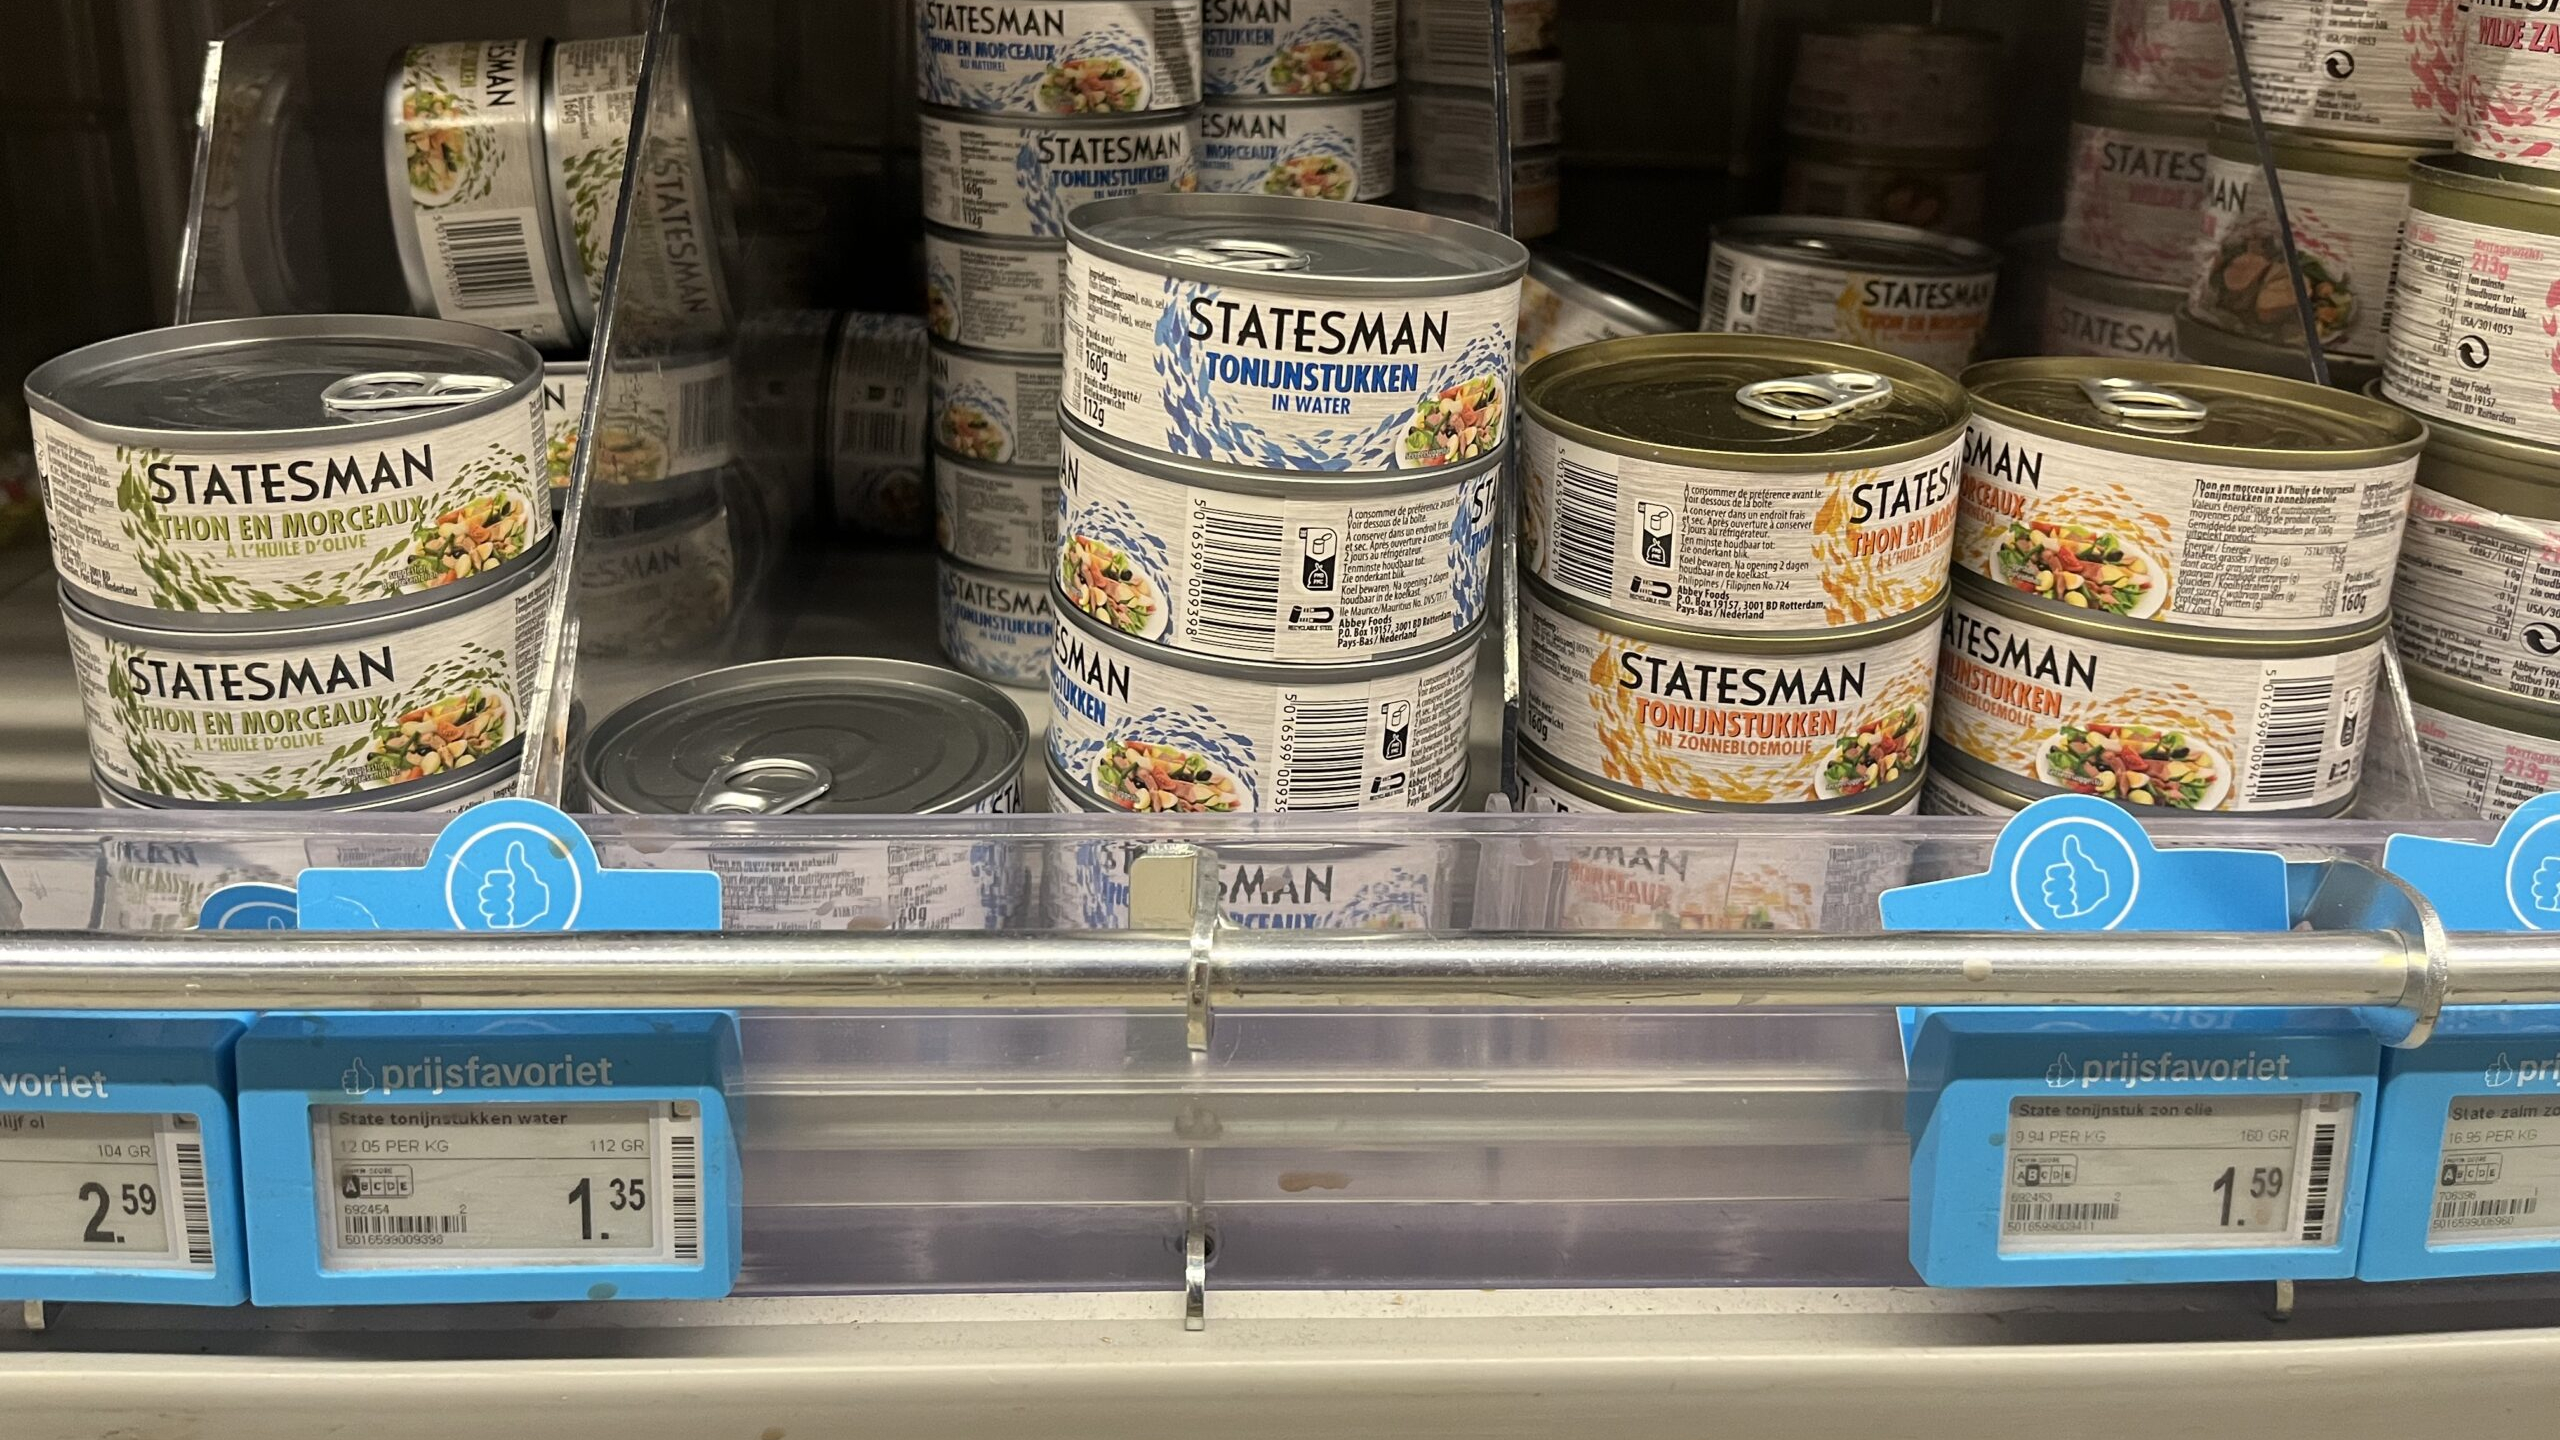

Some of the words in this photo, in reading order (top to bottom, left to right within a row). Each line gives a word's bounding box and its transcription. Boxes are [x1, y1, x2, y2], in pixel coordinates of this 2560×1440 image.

[928, 1, 1064, 36] STATESMAN
[2479, 16, 2525, 50] WILDE
[975, 41, 1056, 62] MORCEAUX
[1038, 131, 1181, 164] STATESMAN
[2472, 253, 2509, 280] 213g
[1187, 297, 1449, 356] STATESMAN
[1086, 350, 1109, 381] 160g
[1205, 351, 1419, 394] TONIJNSTUKKEN
[1083, 396, 1105, 427] 112g
[1272, 394, 1288, 411] IN
[1295, 396, 1351, 416] WATER
[149, 443, 434, 505] STATESMAN
[1691, 486, 1736, 498] consommer
[1738, 489, 1748, 498] de
[1750, 490, 1790, 501] préférence
[1792, 490, 1813, 499] avant
[2220, 483, 2231, 492] en
[2233, 484, 2275, 494] morceaux
[159, 514, 230, 541] THON
[240, 514, 272, 540] EN
[282, 495, 426, 540] MORCEAUX
[1682, 516, 1690, 524] et
[1691, 517, 1706, 526] sec.
[1707, 518, 1729, 529] Après
[1731, 519, 1768, 529] ouverture
[1769, 519, 1774, 530] à
[1776, 521, 1812, 530] conserver
[304, 533, 367, 555] D'OLIVE
[1191, 511, 1205, 570] 016599
[1852, 525, 1902, 558] THON
[1906, 517, 1925, 546] EN
[1343, 561, 1381, 573] Tenminste
[1382, 559, 1414, 571] houdbaar
[1679, 555, 1696, 565] Koel
[1697, 558, 1733, 570] bewaren.
[1735, 560, 1745, 570] Na
[1746, 561, 1778, 573] opening
[1779, 561, 1785, 570] 2
[1786, 561, 1809, 572] dagen
[1341, 585, 1357, 595] Koel
[1359, 583, 1390, 594] bewaren.
[1393, 581, 1402, 590] Na
[1403, 577, 1428, 590] opening
[1428, 576, 1433, 585] 2
[1433, 571, 1449, 584] dagen
[1677, 585, 1703, 599] Abbey
[1705, 588, 1730, 600] Foods
[1678, 575, 1719, 589] Philippines
[1726, 579, 1761, 592] Filipijnen
[1762, 581, 1789, 590] No.724
[1186, 579, 1200, 635] 009398
[1676, 604, 1713, 617] Pays-Bas
[1719, 608, 1765, 619] Nederland
[2341, 594, 2368, 614] 160g
[1338, 617, 1366, 629] Abbey
[1368, 615, 1392, 626] Foods
[1338, 628, 1352, 638] P.O.
[1354, 626, 1368, 637] Box
[1370, 624, 1394, 637] 19157,
[1395, 622, 1412, 632] 3001
[1412, 618, 1421, 628] BD
[1337, 637, 1373, 649] Pays-Bas
[1380, 630, 1417, 641] Nederland
[128, 646, 395, 702] STATESMAN
[1619, 651, 1867, 706] STATESMAN
[138, 704, 197, 734] THON
[203, 712, 234, 735] EN
[241, 695, 386, 735] MORCEAUX
[1636, 696, 1838, 739] TONIJNSTUKKEN
[2256, 684, 2274, 738] 016599
[1280, 706, 1296, 761] 016599
[1528, 710, 1548, 741] 160g
[264, 732, 325, 750] D'OLIVE
[1655, 729, 1674, 748] IN
[1678, 733, 1813, 756] ZONNEBLOEMOLIE
[2504, 757, 2550, 785] 213g
[381, 1054, 614, 1096] prijsfavoriet
[2081, 1051, 2290, 1089] prijsfavoriet
[338, 1112, 384, 1126] State
[518, 1111, 568, 1126] water
[2019, 1104, 2061, 1118] State
[2065, 1102, 2144, 1120] tonijnstuk
[2150, 1105, 2179, 1116] zon
[2452, 1106, 2495, 1121] State
[2500, 1104, 2537, 1119] zalm
[385, 1140, 419, 1153] PER
[426, 1140, 449, 1153] KG
[590, 1140, 615, 1152] 112
[621, 1140, 644, 1152] GR
[2050, 1130, 2080, 1142] PER
[2084, 1130, 2107, 1142] KG
[2240, 1129, 2263, 1142] 160
[2268, 1129, 2290, 1142] GR
[2449, 1131, 2482, 1144] 16.95
[2485, 1130, 2514, 1143] PER
[2518, 1129, 2538, 1141] KG
[98, 1144, 122, 1158] 104
[128, 1145, 152, 1158] GR
[2114, 1192, 2122, 1201] 2
[344, 1204, 390, 1215] 692454
[459, 1204, 468, 1215] 2
